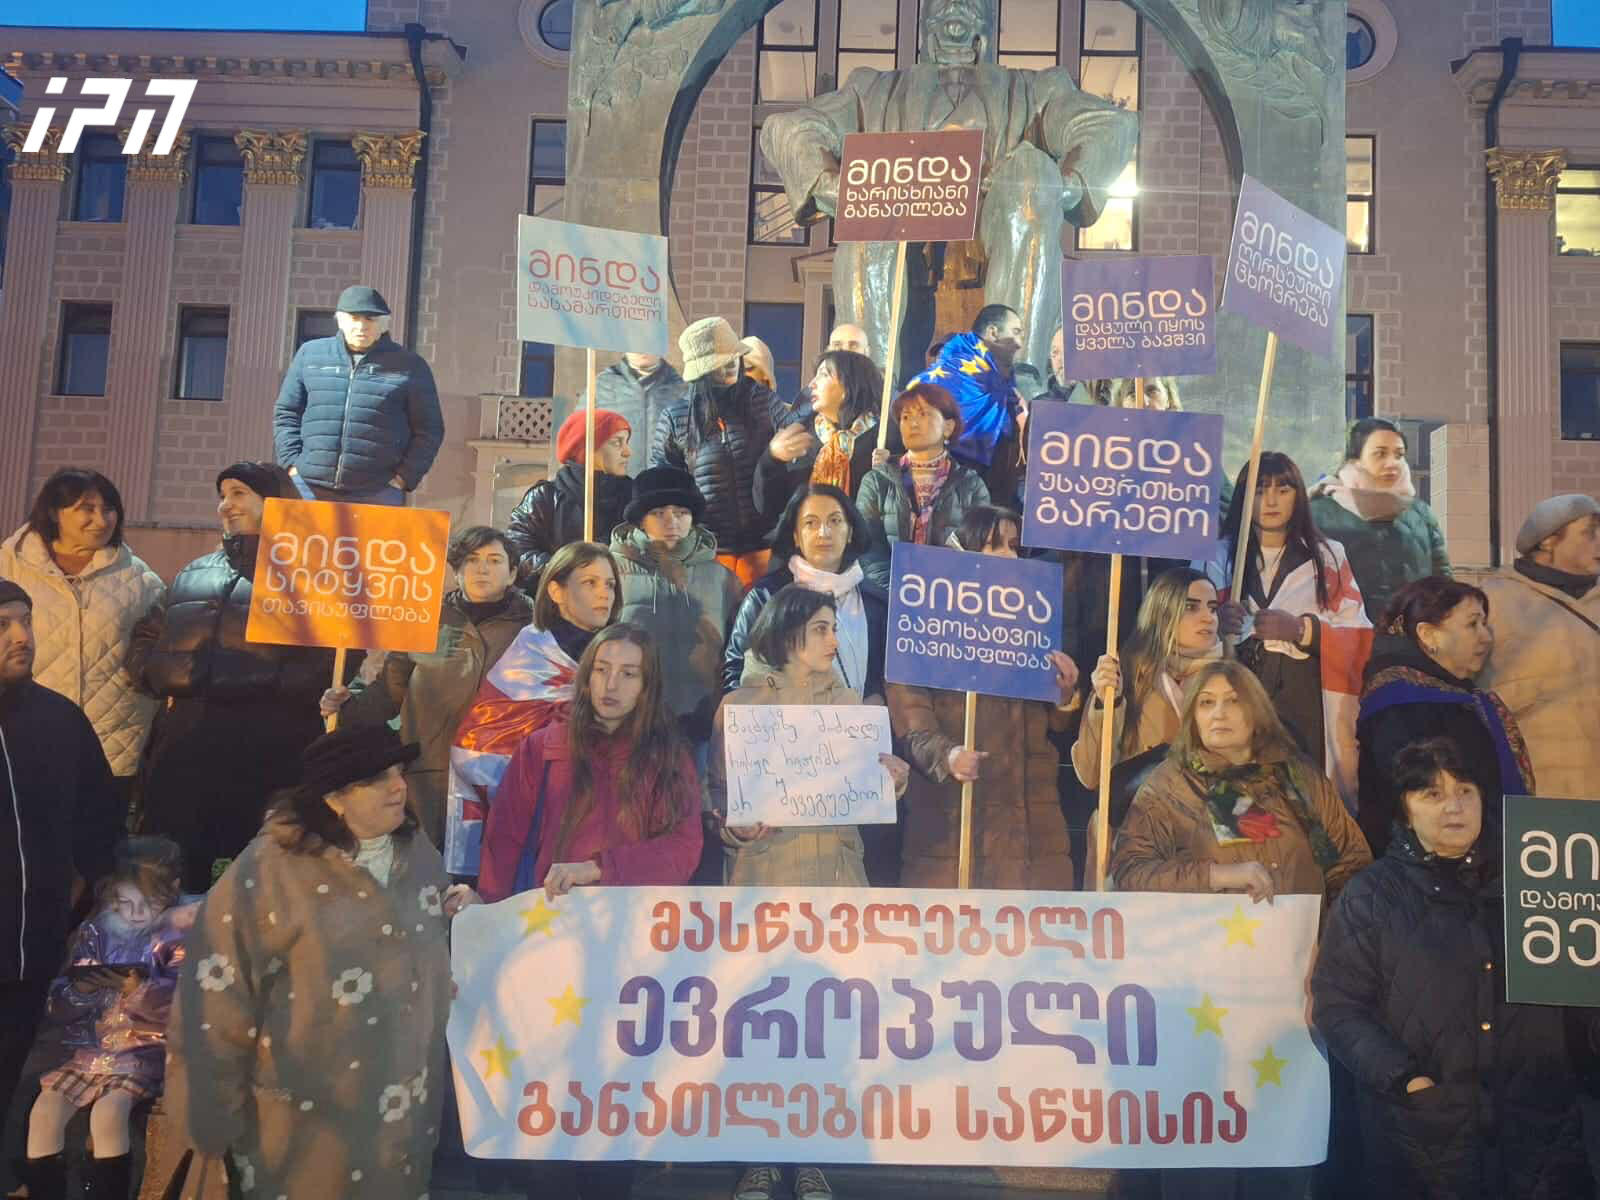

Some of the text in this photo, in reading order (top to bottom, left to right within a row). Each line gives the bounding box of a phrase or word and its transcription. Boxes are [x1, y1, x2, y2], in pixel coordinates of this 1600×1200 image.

[847, 155, 972, 185] მინდა
[844, 202, 967, 218] განათლება
[846, 185, 969, 202] ხარისხიანი
[1240, 211, 1334, 289] მინდა
[529, 250, 660, 294] მინდა
[1238, 243, 1331, 309] ღირსეული
[527, 294, 662, 321] სასამართლო
[528, 281, 661, 308] დამოუკიდებელი
[1071, 288, 1207, 322] მინდა
[1235, 259, 1328, 327] ცხოვრება
[1075, 318, 1205, 336] დაცული იყოს
[1075, 333, 1206, 351] ყველა ბავშვი
[1040, 432, 1213, 477] მინდა
[1039, 472, 1210, 504] უსაფრთხო
[1036, 496, 1209, 536] გარემო
[270, 532, 437, 576] მინდა
[266, 565, 433, 601] სიტყვის
[900, 573, 1052, 624] მინდა
[262, 597, 431, 624] თავისუფლება
[898, 614, 1051, 649] გამოხატვის
[896, 637, 1052, 671] თავისუფლება
[1520, 889, 1600, 911] დამო
[649, 900, 1125, 960] მასწავლებელი
[616, 975, 1158, 1066] ევროპული
[517, 1081, 1248, 1145] განათლების საწყისია
